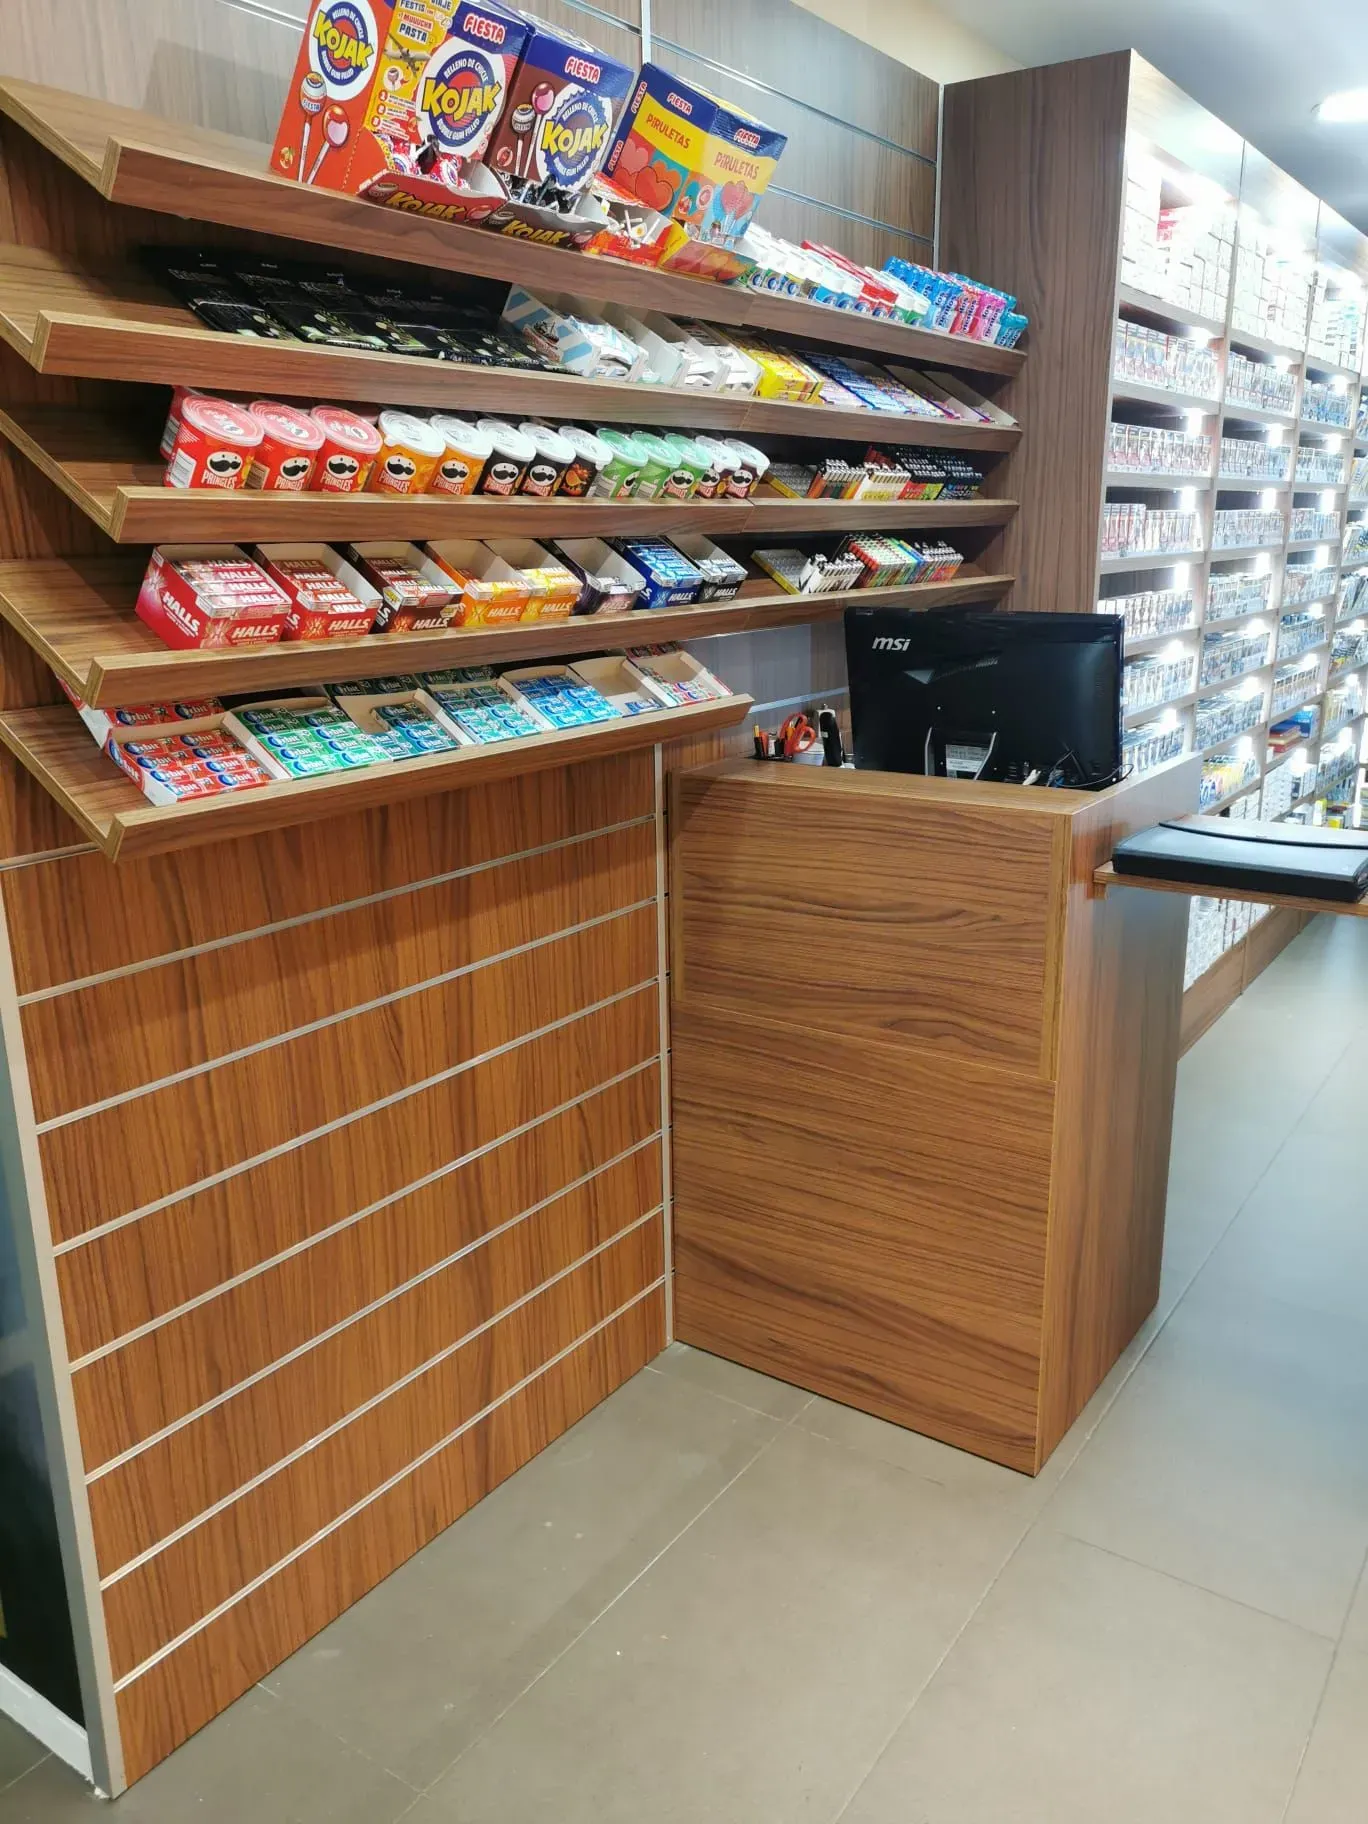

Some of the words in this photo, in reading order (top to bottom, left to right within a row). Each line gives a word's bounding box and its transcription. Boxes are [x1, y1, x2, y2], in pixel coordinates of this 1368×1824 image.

[399, 23, 428, 43] PASTA
[464, 14, 506, 44] FIESTA
[313, 8, 374, 71] KOJAK
[443, 58, 467, 79] RELLENO
[475, 62, 488, 83] CHICLE
[565, 56, 601, 84] FIESTA
[421, 77, 502, 122] KOJAK
[631, 81, 648, 114] FIESTA
[667, 92, 693, 116] FIESTA
[541, 119, 609, 158] KOJAK
[734, 127, 761, 148] FIESTA
[607, 139, 625, 172] FIESTA
[385, 191, 467, 221] KOJAK
[501, 220, 570, 245] KOJAK
[201, 469, 237, 489] PRINGLES
[274, 475, 305, 490] PRINGLES
[320, 471, 353, 491] PRINGLES
[378, 472, 410, 494] PRINGLES
[433, 476, 463, 495] PRINGLES
[220, 571, 262, 580] HALLS
[229, 582, 272, 591] HALLS
[305, 581, 342, 590] HALLS
[241, 594, 284, 603] HALLS
[317, 593, 357, 602] HALLS
[668, 592, 694, 602] HALLS
[713, 588, 738, 597] HALLS
[162, 592, 200, 636] HALLS
[332, 604, 366, 612] HALLS
[487, 607, 521, 617] HALLS
[542, 603, 573, 613] HALLS
[328, 619, 371, 631] HALLS
[412, 617, 450, 630] HALLS
[231, 625, 279, 639] HALLS
[872, 637, 911, 651] msi
[116, 710, 152, 725] Orbit
[174, 704, 208, 720] Orbit
[243, 711, 275, 723] Orbit
[304, 714, 335, 727] Orbit
[255, 723, 286, 734] Orbit
[316, 728, 346, 739] Orbit
[180, 734, 213, 746] Orbit
[268, 735, 300, 748] Orbit
[124, 740, 160, 755] Orbit
[192, 747, 225, 759] Orbit
[280, 748, 312, 760] Orbit
[137, 756, 172, 769] Orbit
[205, 760, 240, 773] Orbit
[150, 769, 186, 782] Orbit
[218, 774, 251, 786] Orbit
[164, 783, 199, 796] Orbit
